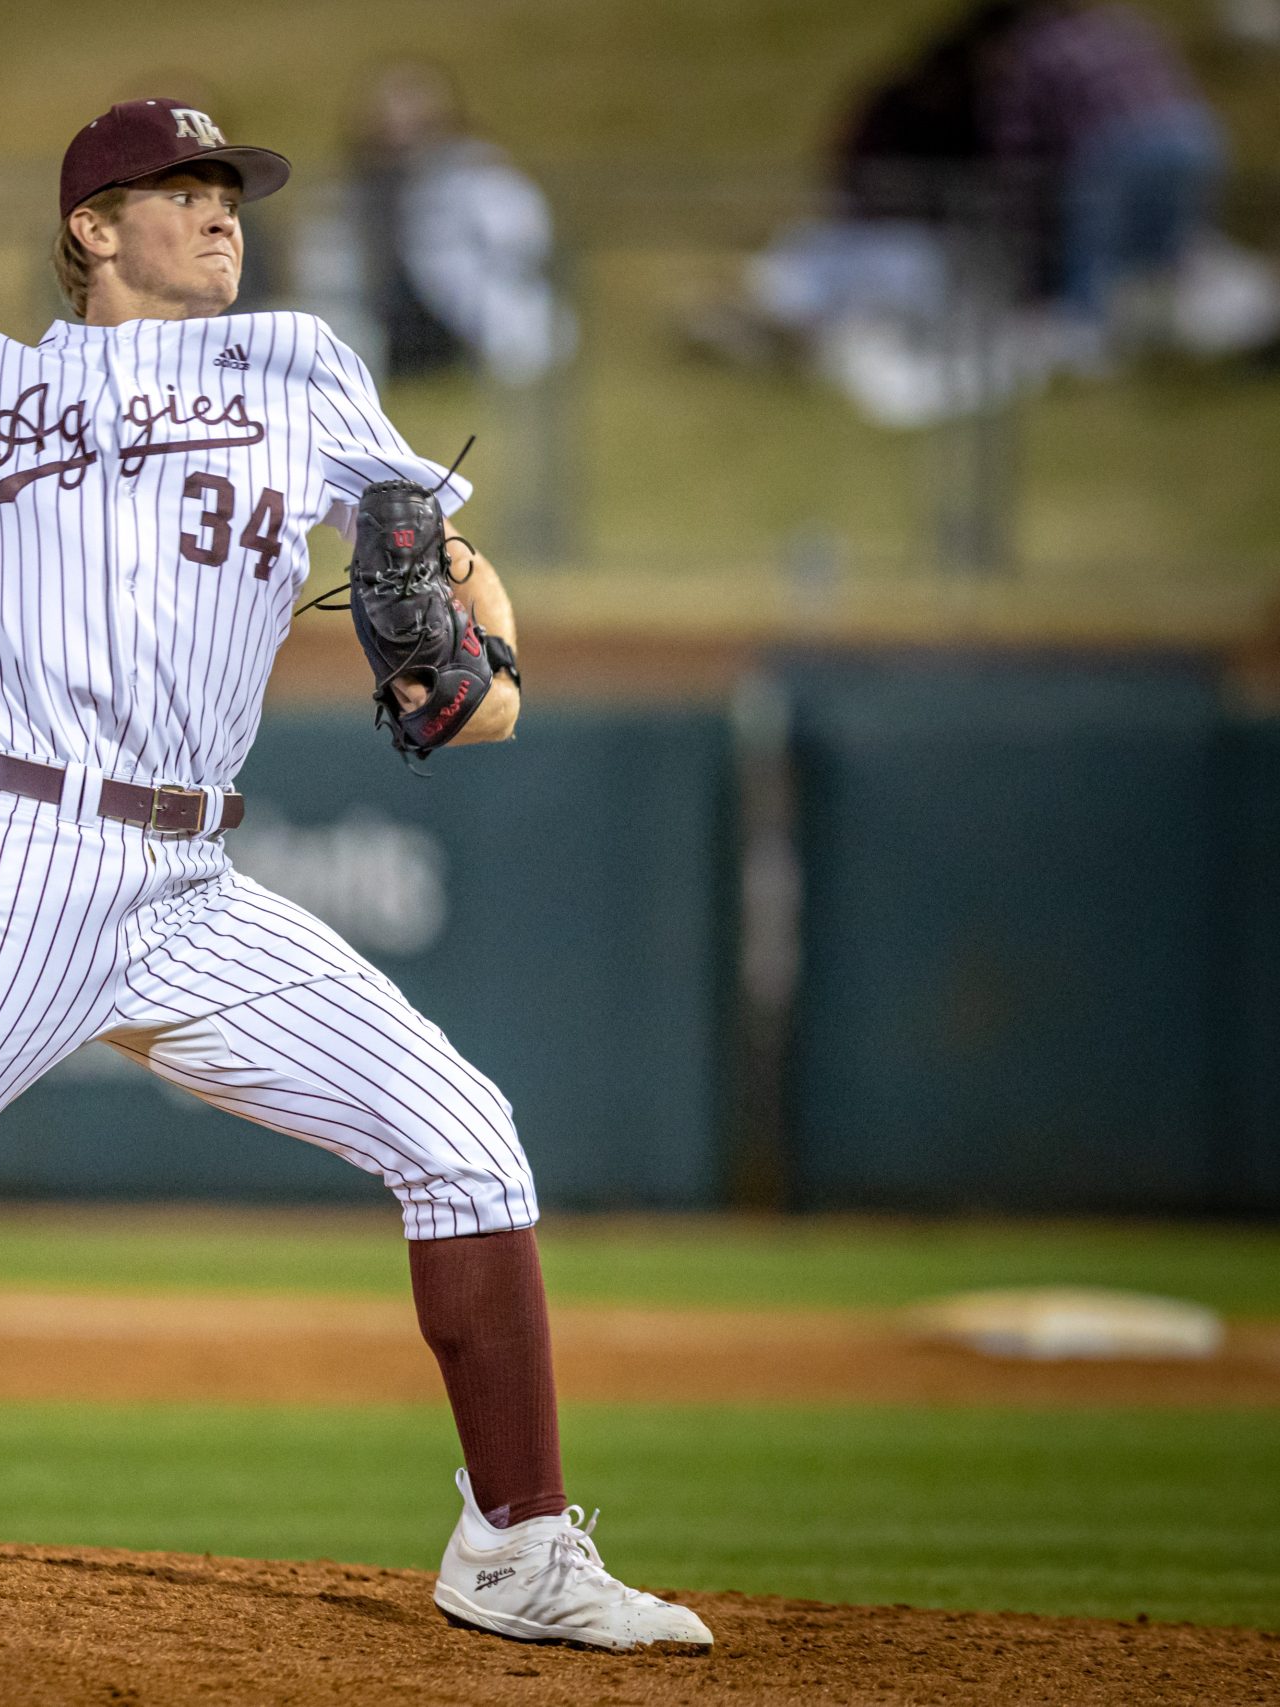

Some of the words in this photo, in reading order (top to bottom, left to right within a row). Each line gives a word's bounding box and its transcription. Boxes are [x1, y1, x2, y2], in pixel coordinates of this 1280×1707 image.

[212, 358, 251, 371] adidas
[180, 471, 284, 582] 34
[474, 1566, 517, 1590] Aggies
